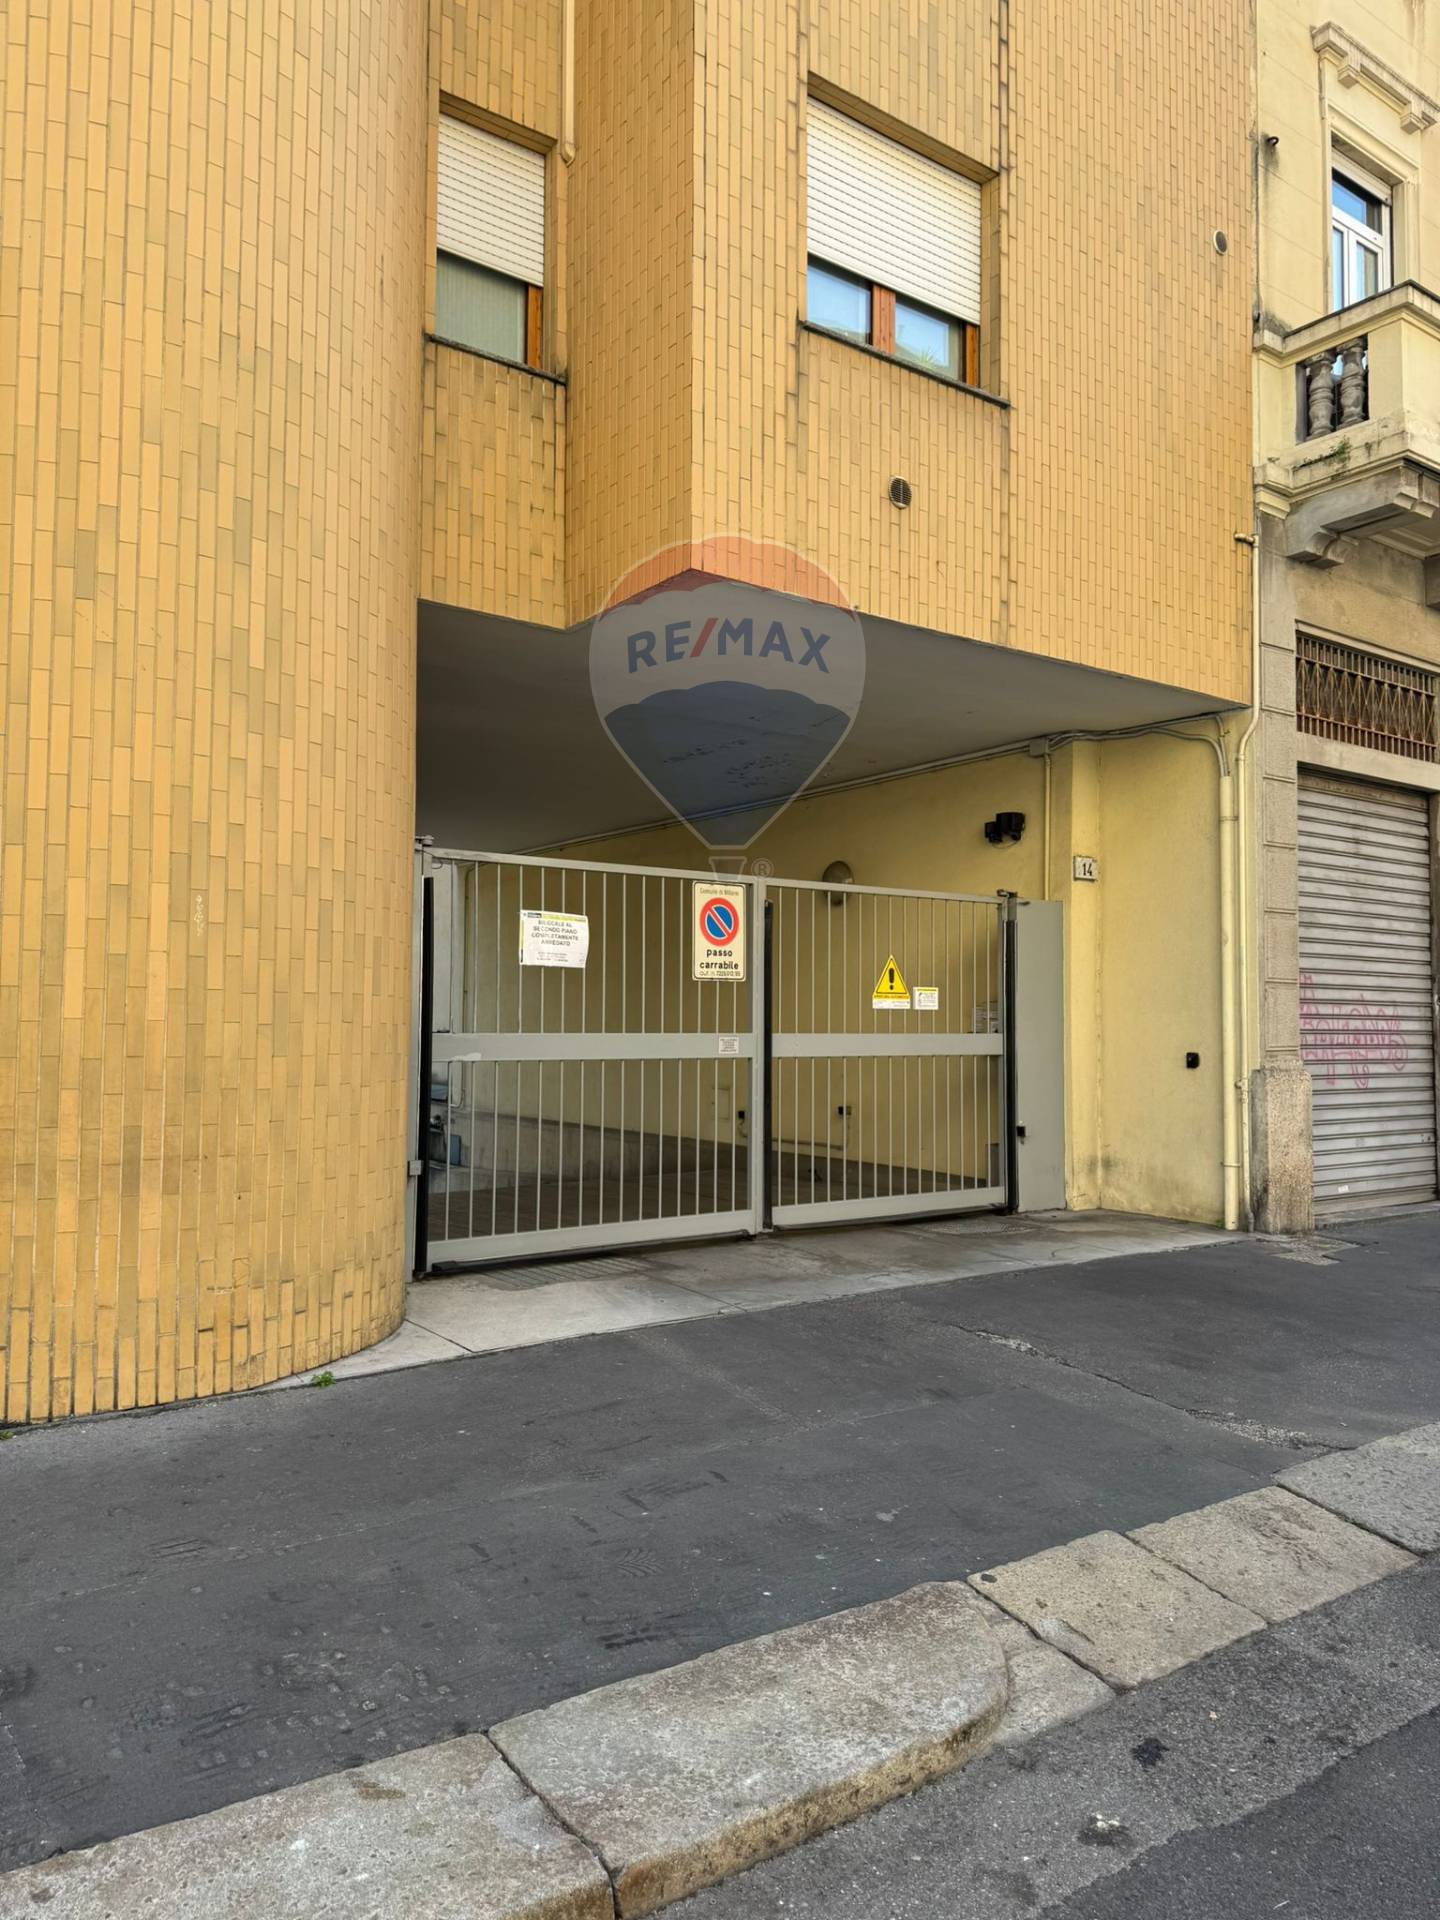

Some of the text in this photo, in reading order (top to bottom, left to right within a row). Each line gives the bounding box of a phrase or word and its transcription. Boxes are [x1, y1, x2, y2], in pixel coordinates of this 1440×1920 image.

[1083, 863, 1092, 876] 14
[706, 949, 733, 958] passo
[699, 960, 739, 970] carrabile
